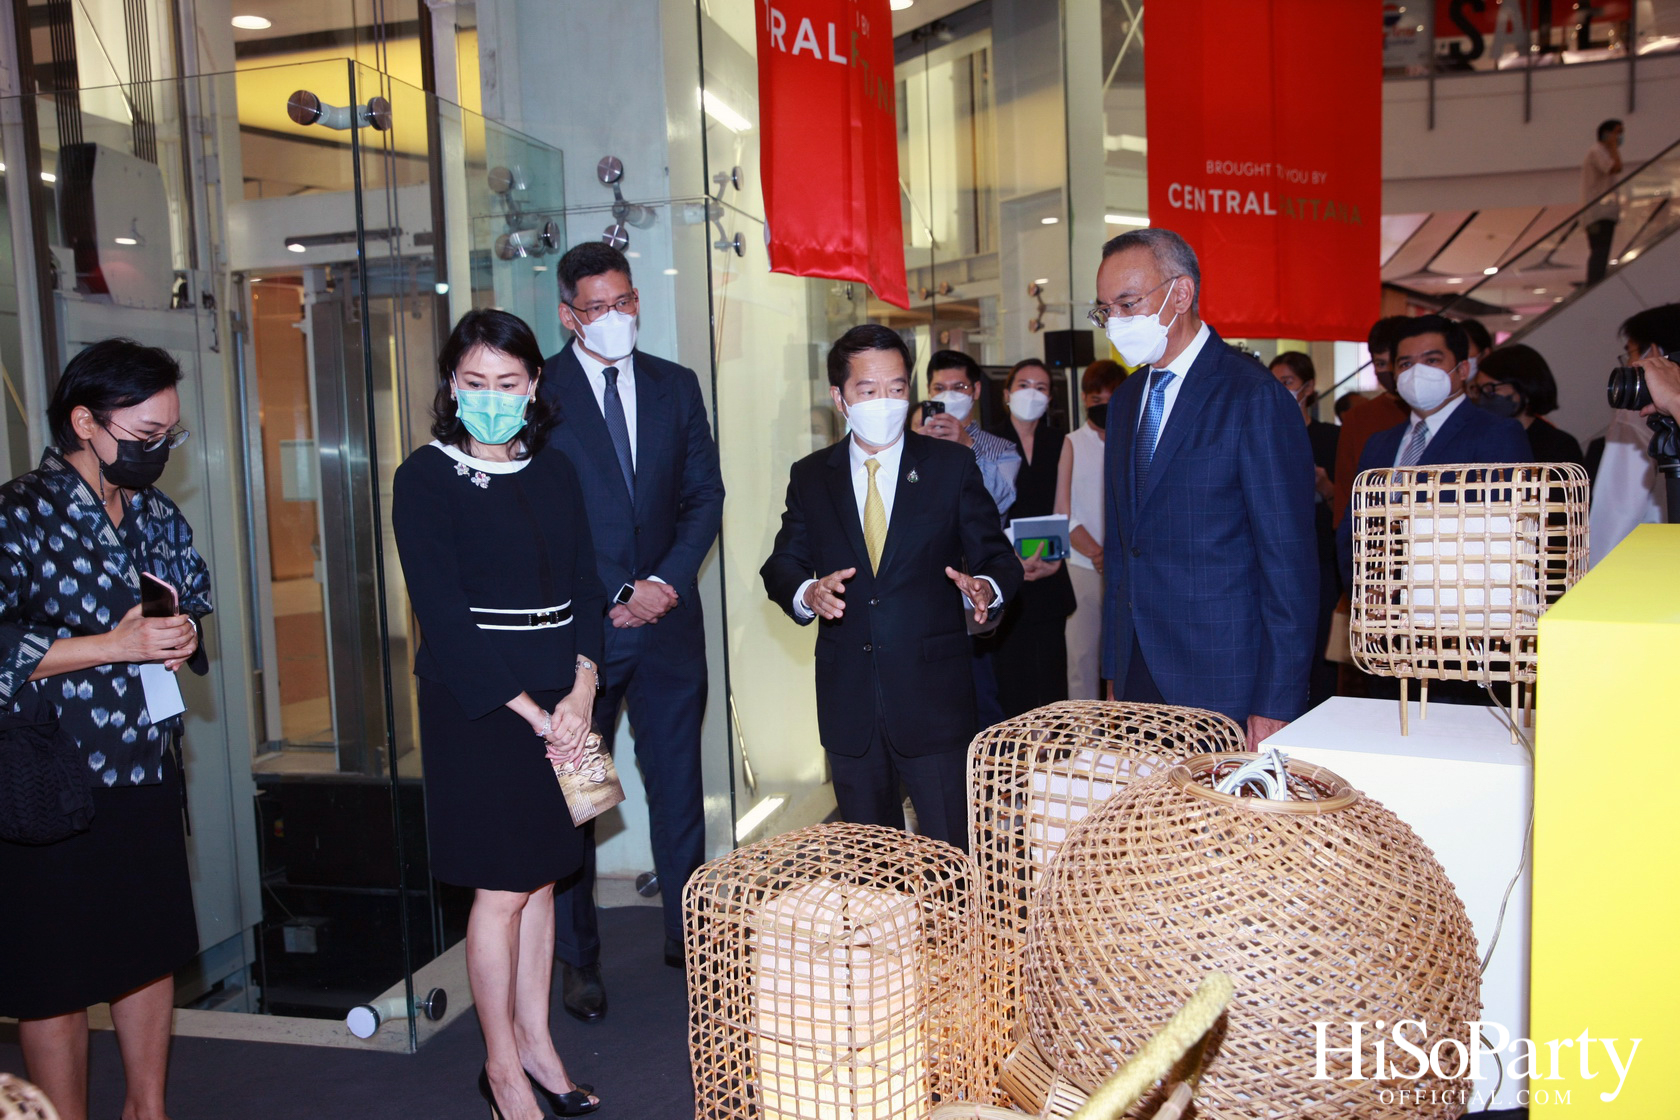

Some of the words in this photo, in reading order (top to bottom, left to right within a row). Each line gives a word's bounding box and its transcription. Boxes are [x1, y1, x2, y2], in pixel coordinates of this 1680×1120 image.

[1450, 0, 1612, 60] SALE
[1206, 159, 1272, 176] BROUGHT
[1312, 170, 1328, 184] BY
